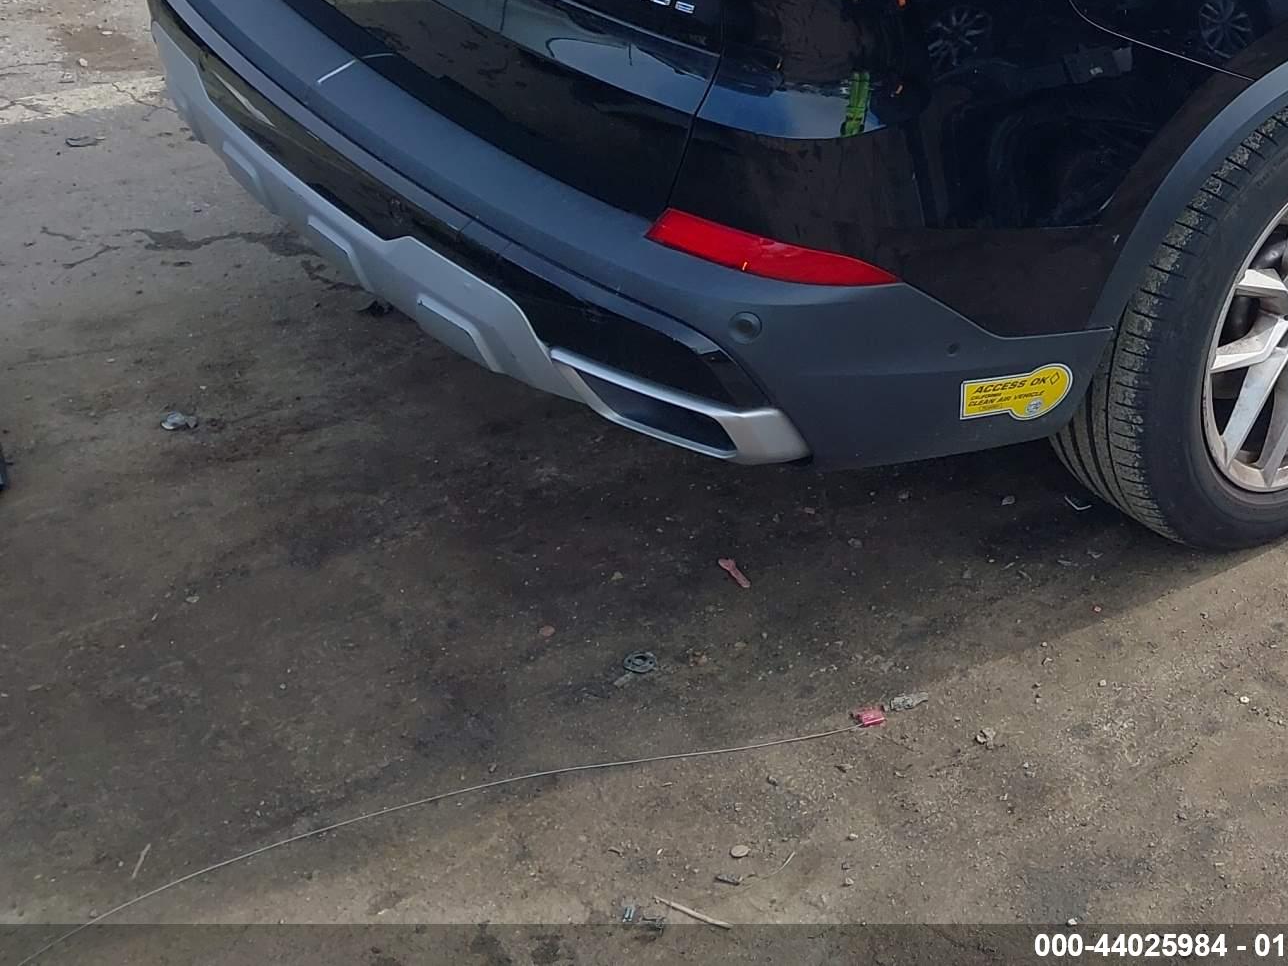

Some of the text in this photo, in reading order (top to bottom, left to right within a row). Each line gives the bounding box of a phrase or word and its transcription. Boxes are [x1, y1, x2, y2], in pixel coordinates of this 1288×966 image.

[973, 376, 1051, 394] ACCESS OK
[968, 398, 996, 407] CLEAN
[997, 395, 1012, 403] AIR
[1013, 390, 1045, 400] VEHICLE
